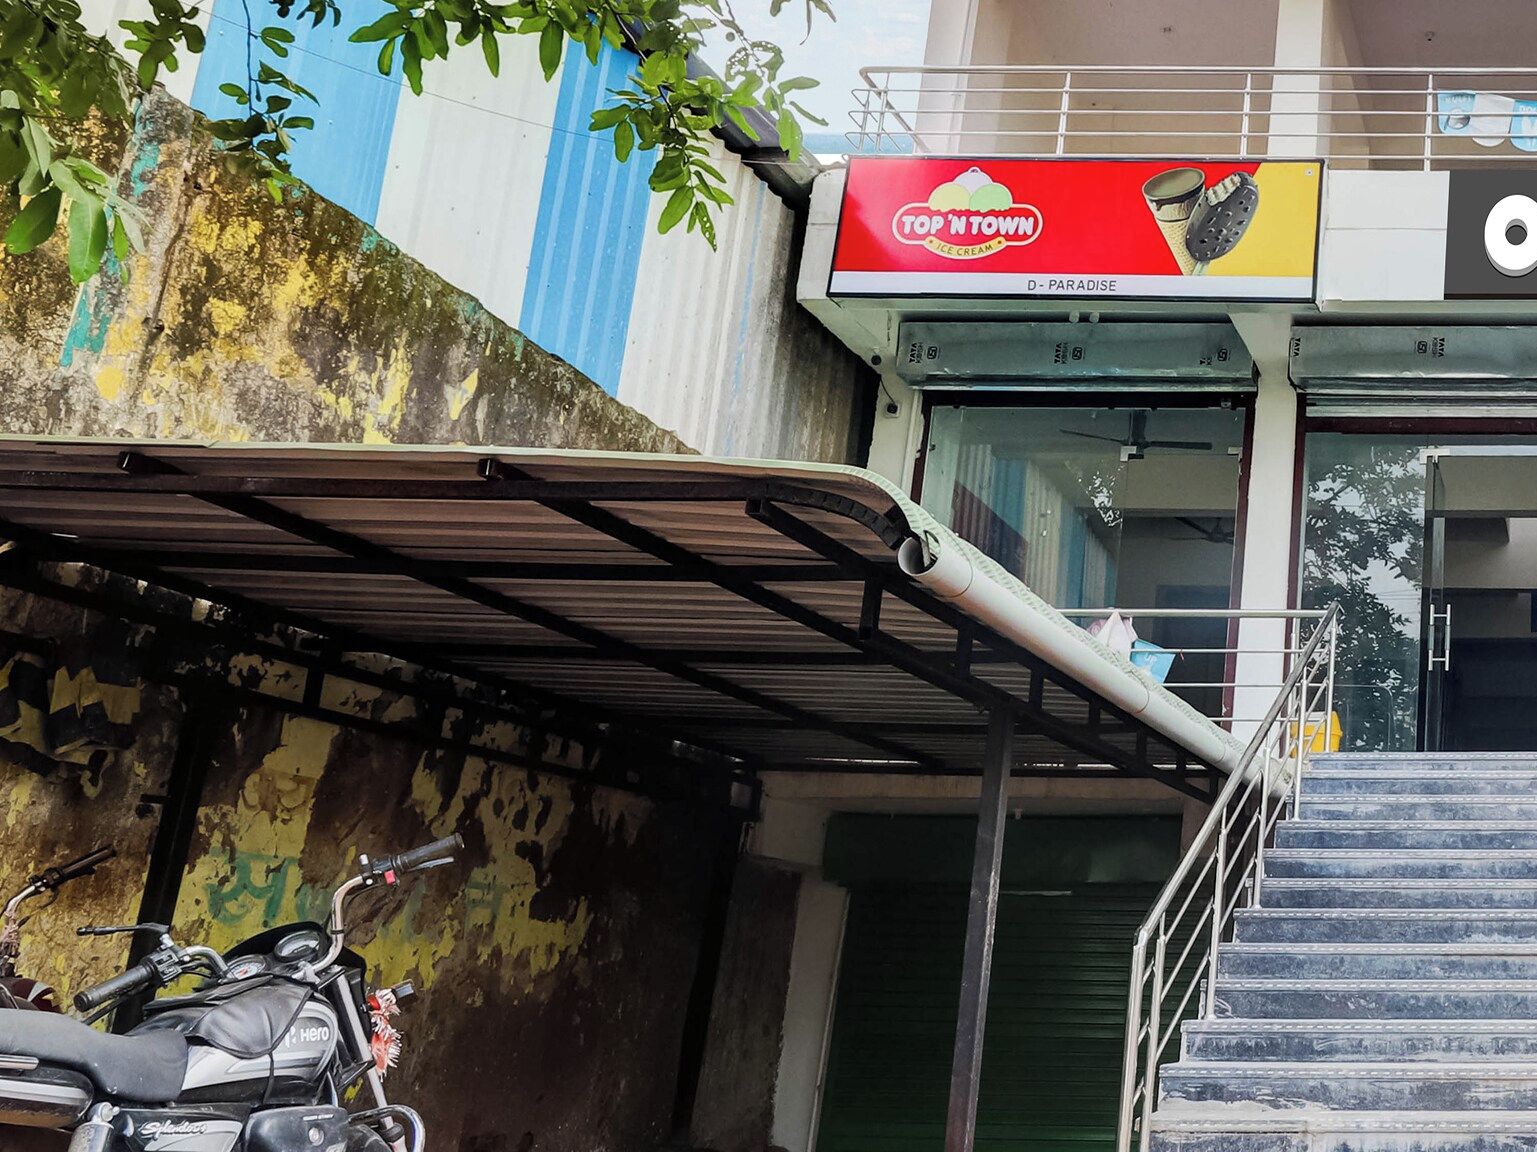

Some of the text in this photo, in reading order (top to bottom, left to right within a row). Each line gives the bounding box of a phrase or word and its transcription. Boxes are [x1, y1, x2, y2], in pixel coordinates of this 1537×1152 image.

[901, 215, 944, 236] TOP
[969, 215, 1035, 237] TOWN
[937, 243, 994, 257] ICE CREAM
[1048, 279, 1118, 293] PARADISE
[300, 1026, 330, 1042] Hero
